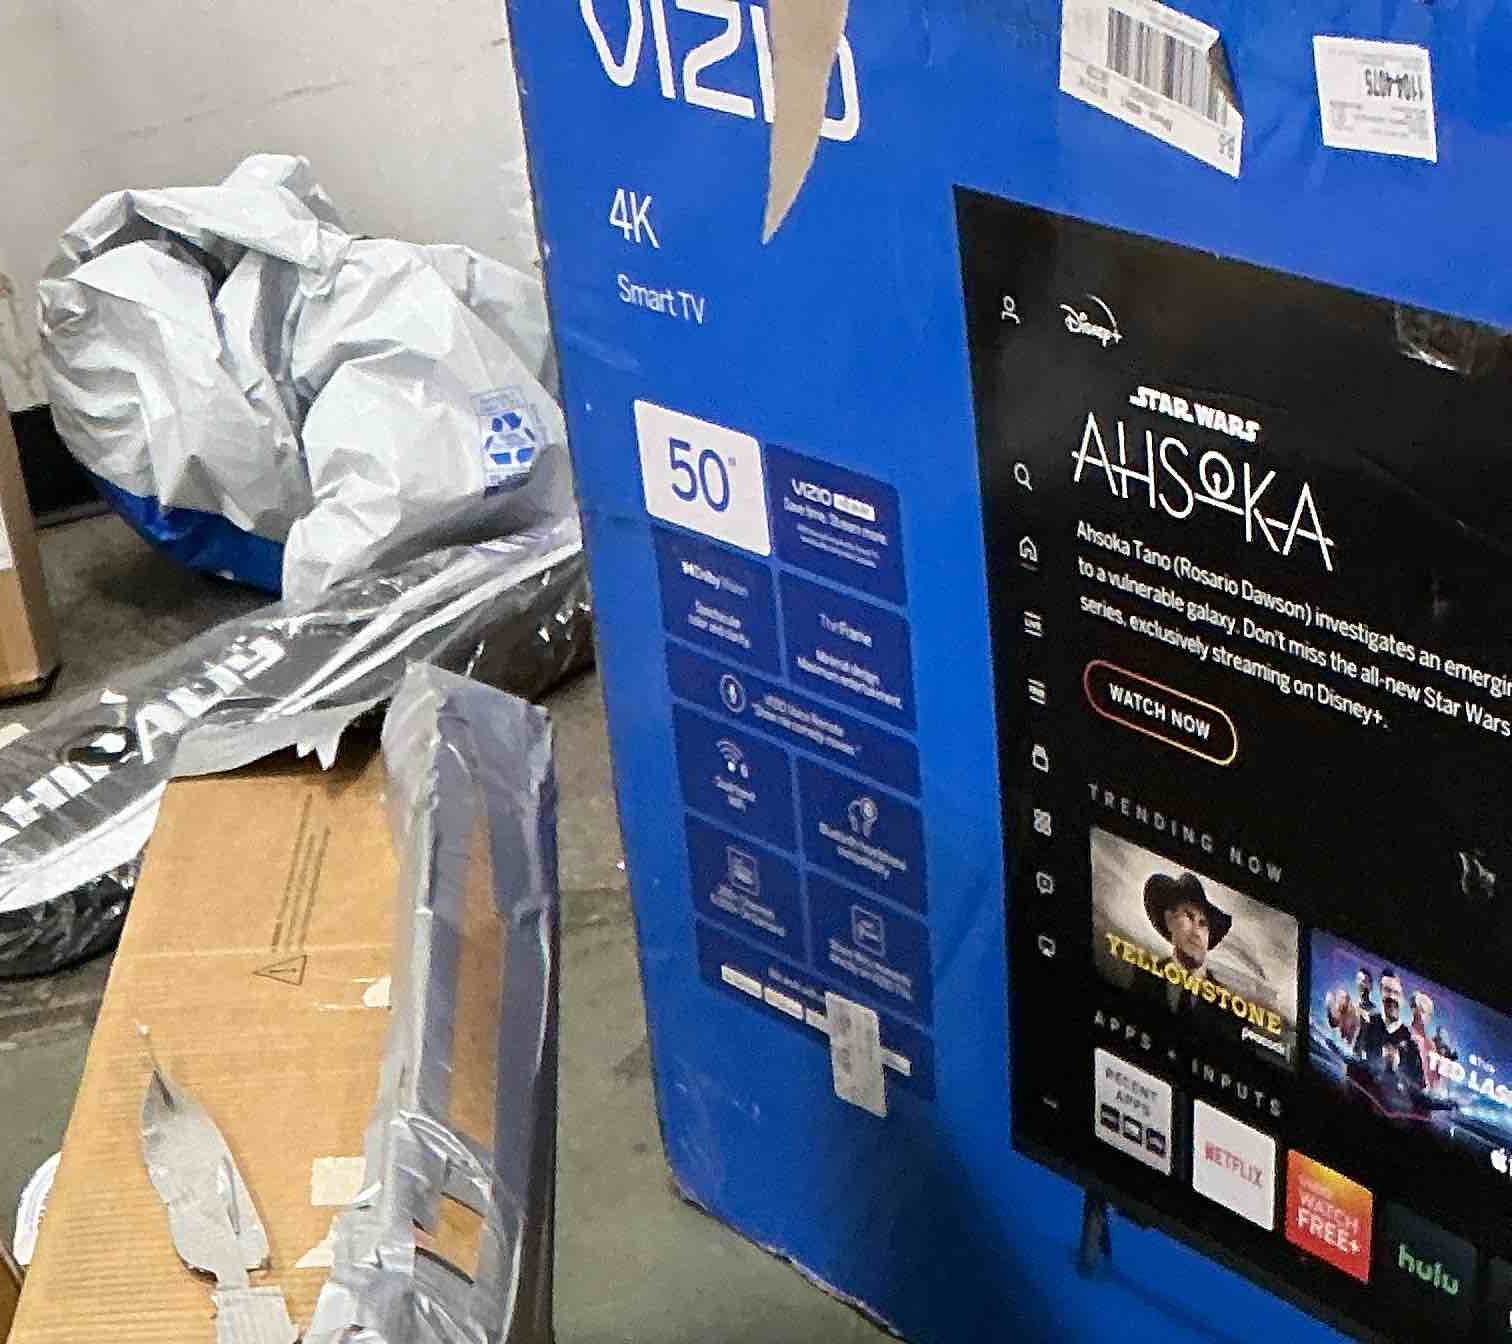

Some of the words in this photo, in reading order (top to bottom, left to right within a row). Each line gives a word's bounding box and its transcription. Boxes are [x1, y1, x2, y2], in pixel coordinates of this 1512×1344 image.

[609, 188, 660, 248] 4K
[616, 273, 677, 317] Smart
[677, 291, 705, 325] TV
[1129, 386, 1194, 424] STAR
[1194, 403, 1262, 443] WARS
[1071, 411, 1335, 572] AHSOKA
[1076, 519, 1130, 556] Ahsoka
[1132, 539, 1171, 571] Tano
[1174, 556, 1238, 595] (Rosario
[1242, 580, 1312, 627] Dawson)
[1315, 602, 1416, 662] investigates
[1419, 650, 1440, 671] an
[1078, 556, 1094, 579] to
[1096, 567, 1107, 583] a
[1109, 567, 1185, 612] vulnerable
[1187, 598, 1240, 635] galaxy.
[1243, 622, 1287, 653] Don't
[1289, 640, 1328, 669] miss
[1330, 650, 1358, 678] the
[1359, 664, 1420, 702] all-new
[1423, 686, 1461, 718] Star
[1465, 700, 1511, 737] Wars
[1080, 595, 1126, 627] series,
[1129, 614, 1209, 661] exclusively
[1212, 644, 1291, 695] streaming
[1294, 680, 1314, 699] on
[1109, 683, 1166, 724] WATCH
[1171, 706, 1211, 741] NOW
[1090, 784, 1214, 854] TRENDING
[1229, 847, 1283, 884] NOW
[1104, 933, 1283, 1035] YELLOWSTONE
[1094, 1010, 1153, 1051] APPS
[1191, 1058, 1283, 1117] INPUTS
[1104, 1067, 1159, 1101] RECENT
[1114, 1089, 1151, 1118] APPS
[1204, 1140, 1264, 1189] NETFLIX
[1296, 1212, 1361, 1256] FREE+
[1299, 1192, 1359, 1230] WATCH
[1398, 1244, 1459, 1295] hulu
